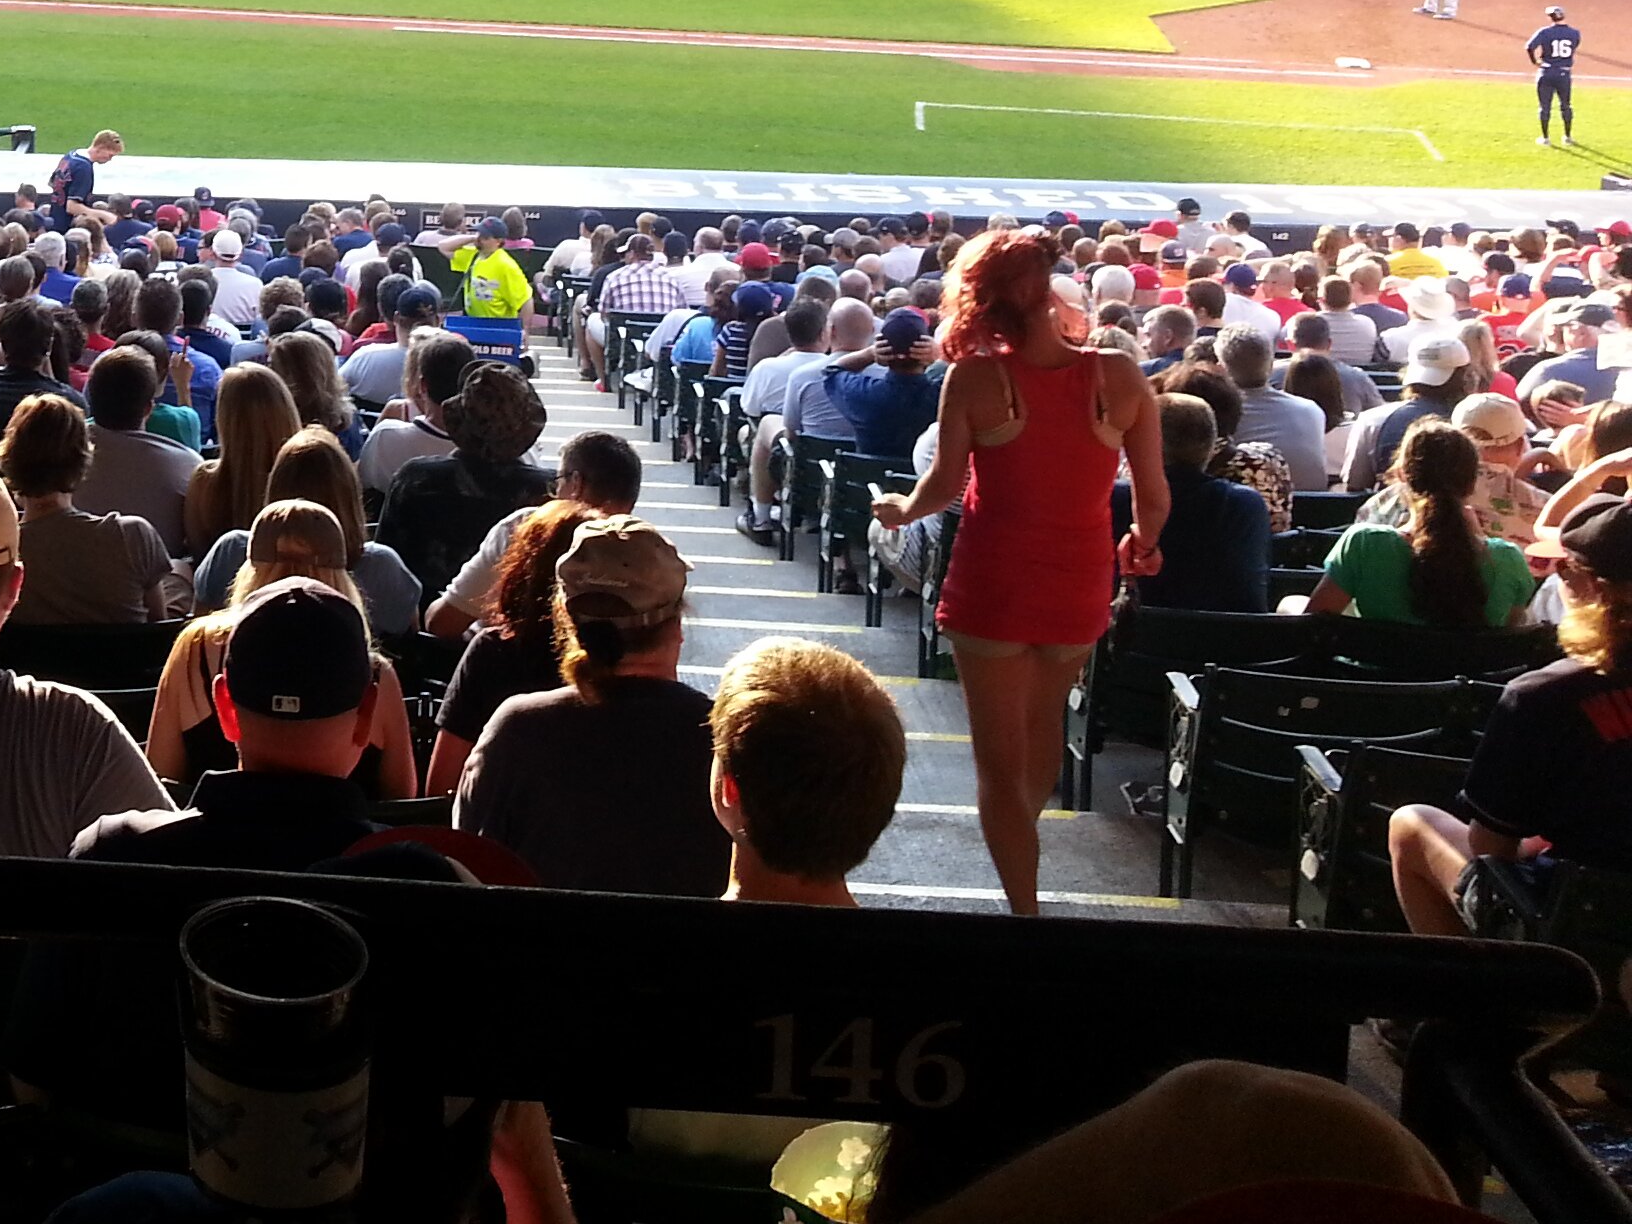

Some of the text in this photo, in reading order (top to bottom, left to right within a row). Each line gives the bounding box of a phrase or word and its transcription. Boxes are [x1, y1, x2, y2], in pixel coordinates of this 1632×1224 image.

[1551, 39, 1572, 57] 16
[491, 346, 514, 356] BEER
[751, 1013, 967, 1109] 146
